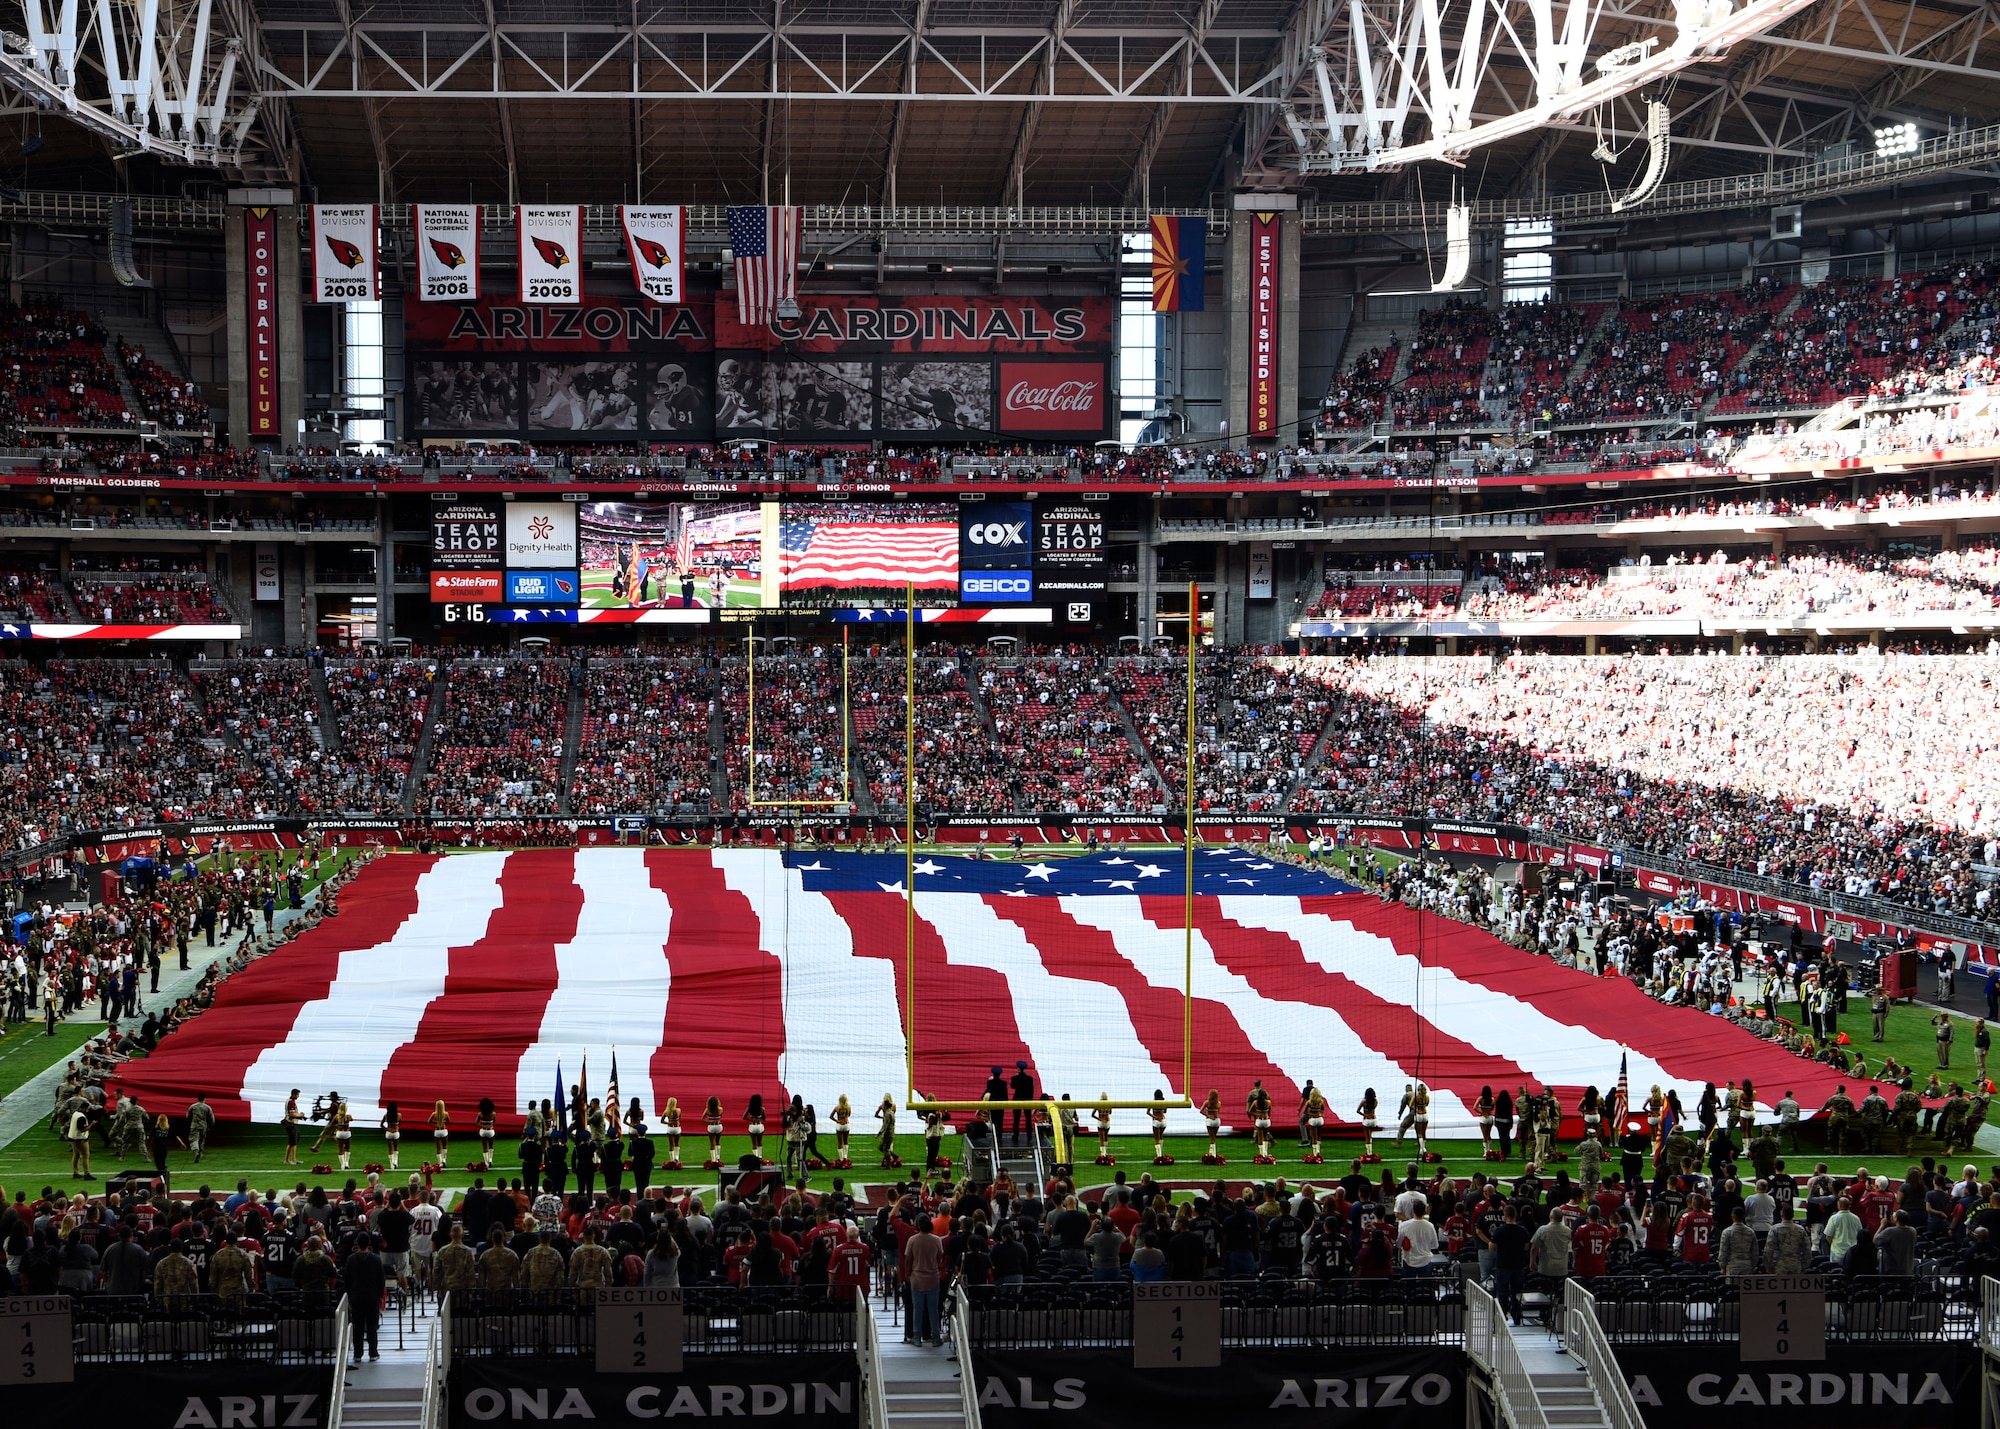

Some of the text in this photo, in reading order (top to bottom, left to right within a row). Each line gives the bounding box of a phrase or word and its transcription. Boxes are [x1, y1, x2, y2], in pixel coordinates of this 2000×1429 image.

[324, 286, 367, 297] 2008
[428, 283, 468, 295] 2008
[530, 286, 571, 297] 2009
[256, 231, 270, 361] FOOTBALL
[1258, 236, 1270, 378] ESTABLISHED
[448, 306, 707, 340] ARIZONA
[768, 308, 1086, 340] CARDINALS
[259, 367, 270, 429] CLUB
[1259, 381, 1268, 431] 1898
[50, 478, 105, 486] MARSHALL
[107, 479, 160, 487] GOLDBERG
[435, 524, 497, 536] TEAM
[968, 521, 1024, 548] COX
[1042, 524, 1102, 536] TEAM
[435, 538, 497, 550] SHOP
[510, 543, 572, 553] Dignity Health
[1042, 537, 1102, 549] SHOP
[519, 578, 541, 586] BUD
[963, 579, 1030, 592] GEICO
[515, 586, 546, 594] LIGHT
[445, 604, 484, 622] 6:16
[1071, 605, 1088, 618] 25
[190, 823, 275, 834] ARIZONA CARDINALS
[1357, 819, 1403, 827] CARDINALS
[1432, 823, 1496, 835] ARIZONA CARDINALS
[102, 829, 162, 842] ARIZONA CARDINALS
[1776, 1187, 1791, 1202] 40
[1669, 1206, 1677, 1217] 11
[1879, 1205, 1889, 1218] 11
[414, 1220, 432, 1235] 40
[1278, 1232, 1296, 1247] 32
[1693, 1227, 1708, 1244] 13
[268, 1244, 284, 1261] 21
[1591, 1239, 1602, 1255] 15
[188, 1253, 206, 1268] 24
[1326, 1250, 1340, 1266] 21
[1617, 1250, 1630, 1264] 34
[847, 1257, 859, 1275] 11
[1743, 1278, 1823, 1290] SECTION
[598, 1290, 681, 1302] SECTION
[1137, 1285, 1218, 1297] SECTION
[0, 1300, 68, 1313] ECTION
[979, 1376, 1086, 1410] ALS
[1269, 1373, 1452, 1409] ARIZO
[1686, 1373, 1954, 1406] CARDINA
[464, 1382, 851, 1421] ONA CARDIN
[173, 1394, 319, 1429] ARIZ
